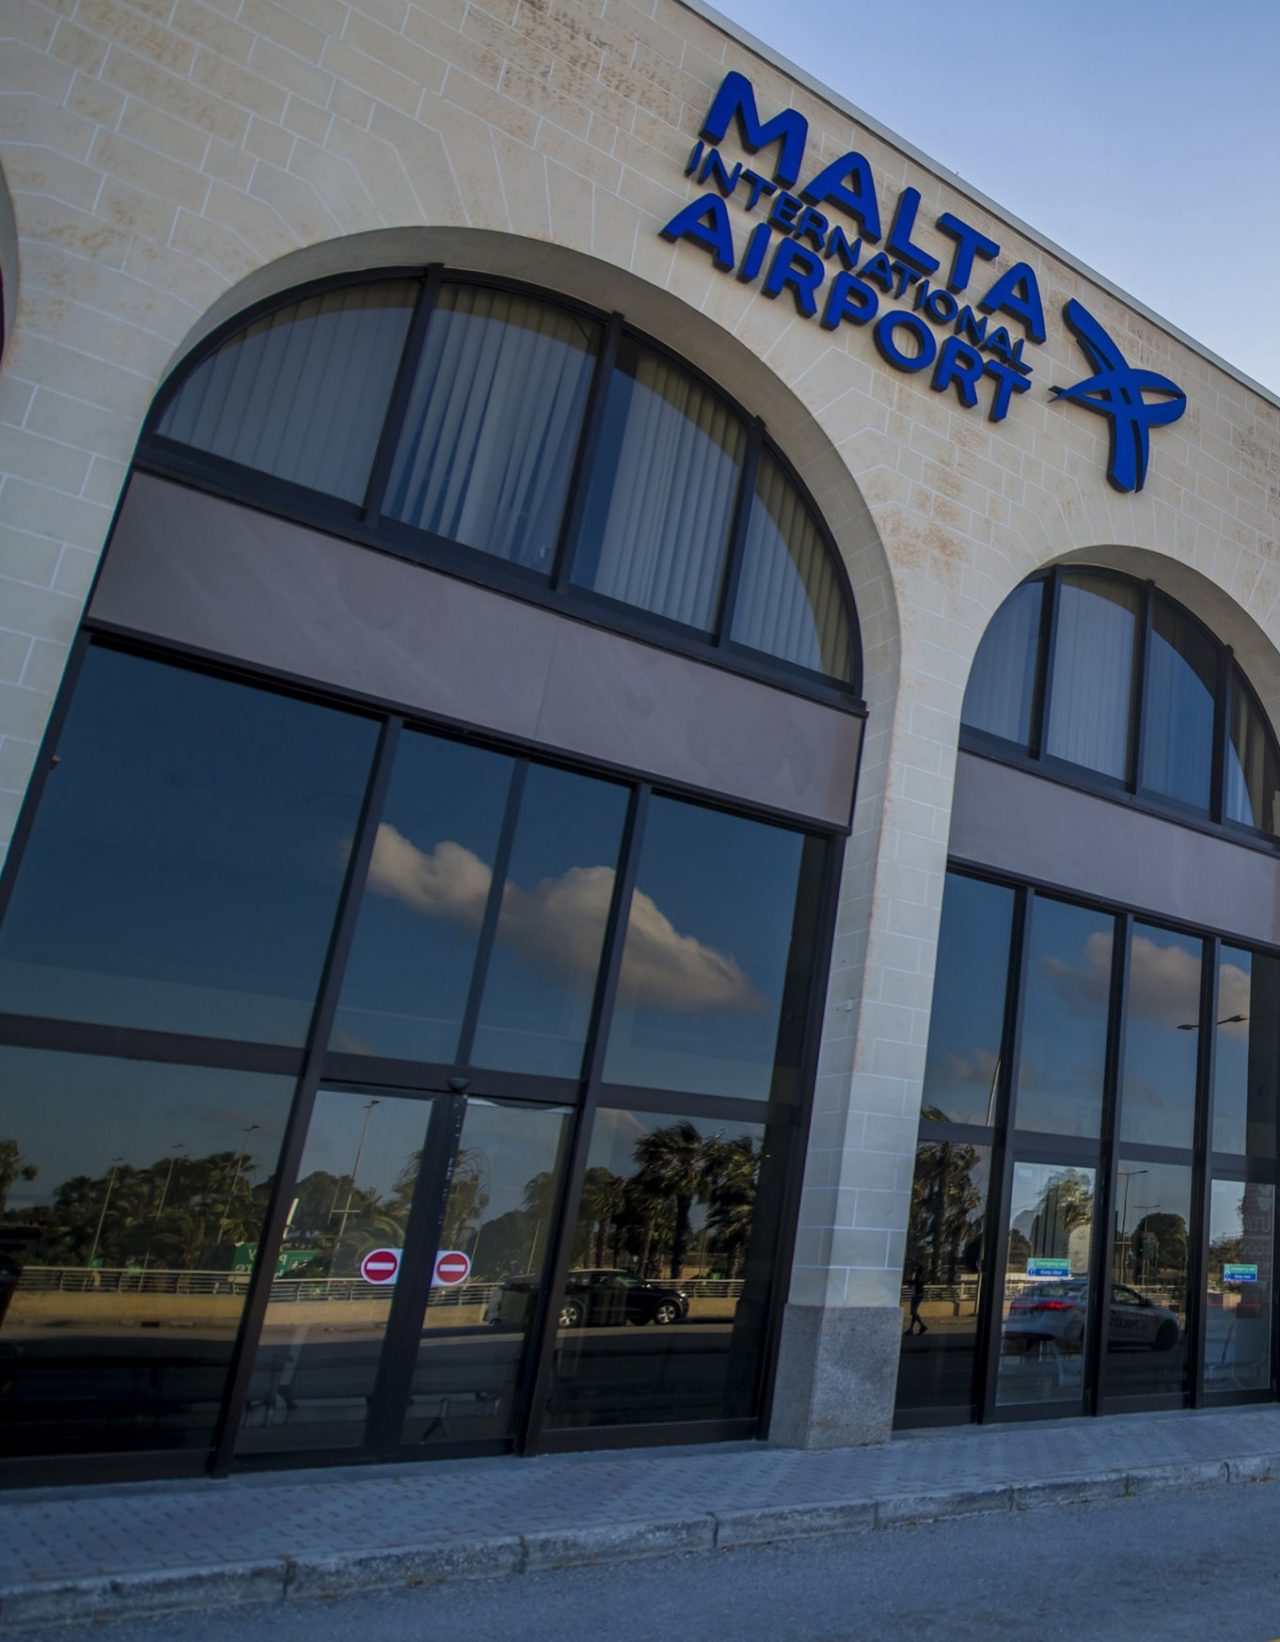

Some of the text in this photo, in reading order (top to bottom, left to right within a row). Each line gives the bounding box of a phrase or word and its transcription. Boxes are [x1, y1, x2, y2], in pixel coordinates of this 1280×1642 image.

[658, 192, 1032, 423] AIRPORT
[684, 140, 1034, 376] INTERNATIONAL
[699, 70, 1047, 345] MALTA
